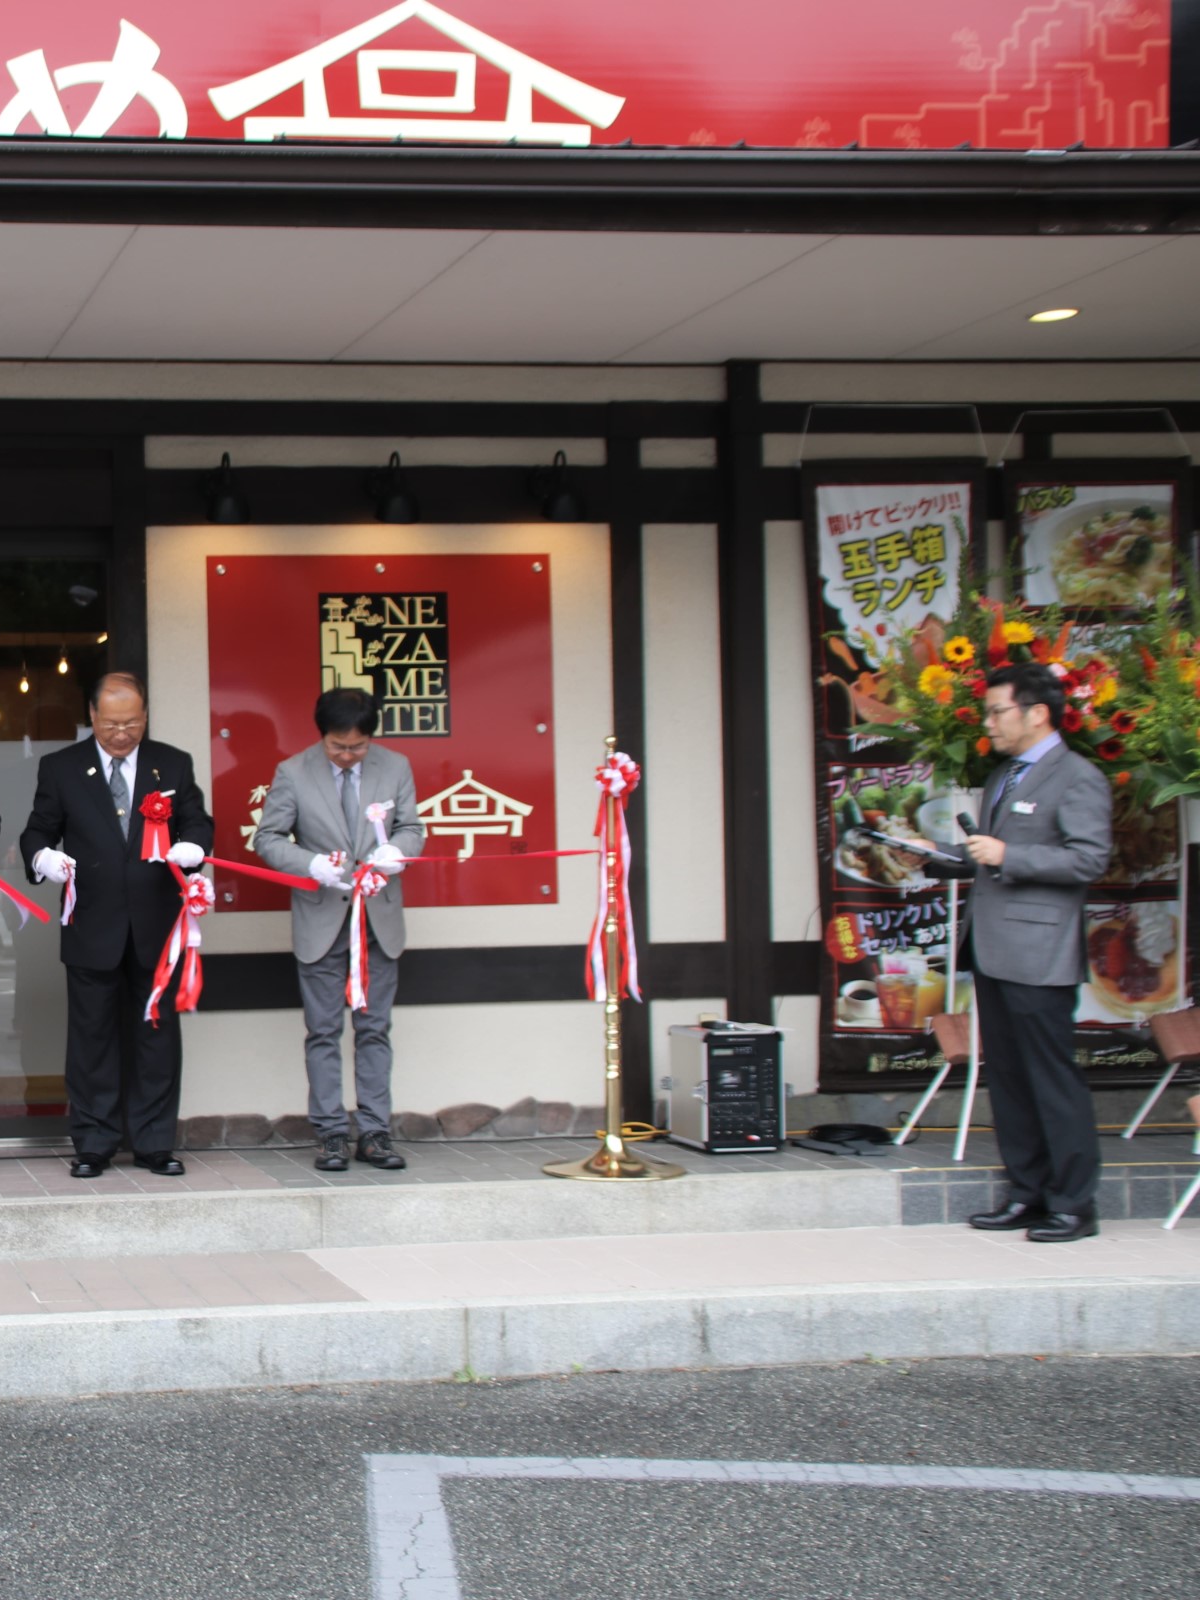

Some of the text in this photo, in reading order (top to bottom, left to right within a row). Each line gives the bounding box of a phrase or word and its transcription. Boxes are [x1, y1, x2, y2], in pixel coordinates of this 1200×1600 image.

[839, 524, 946, 580] 玉手箱
[852, 566, 946, 617] ランチ
[382, 596, 446, 628] NE
[382, 632, 447, 664] ZA
[383, 668, 448, 699] ME
[383, 702, 449, 735] TEI
[860, 930, 912, 956] セット
